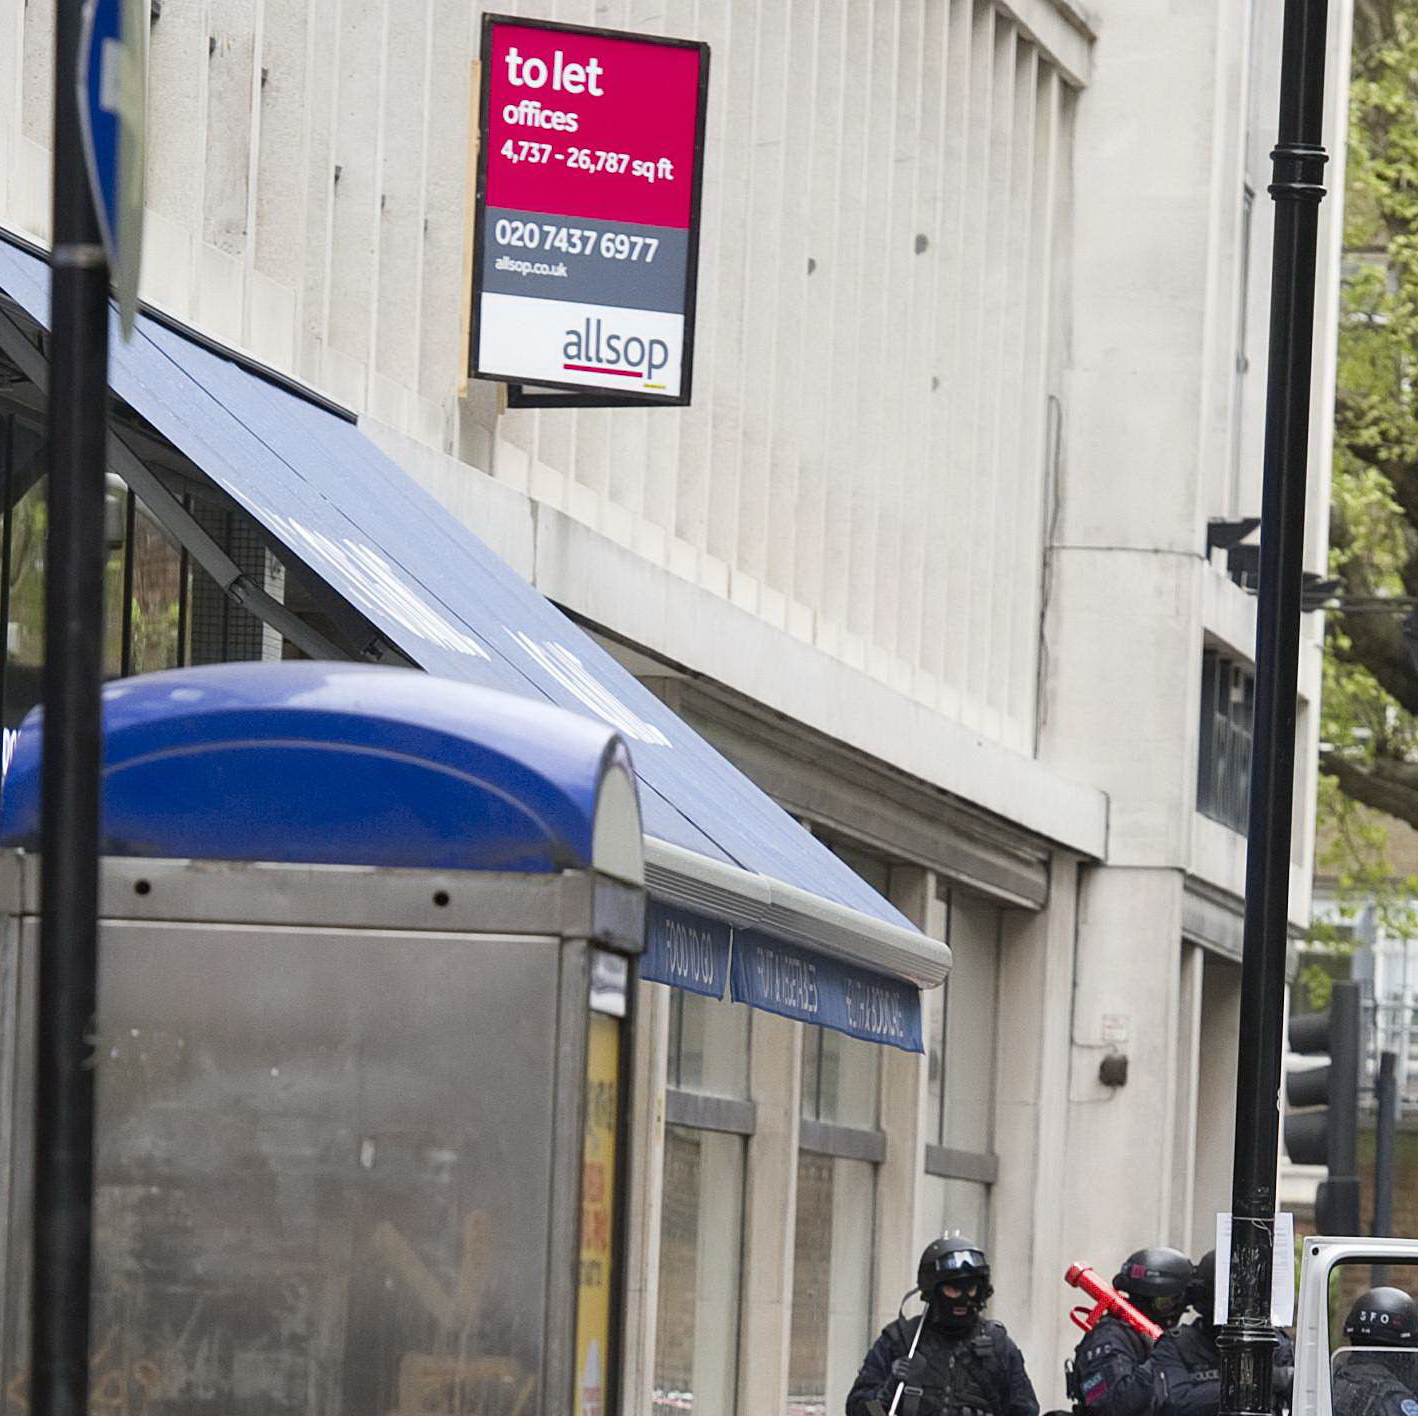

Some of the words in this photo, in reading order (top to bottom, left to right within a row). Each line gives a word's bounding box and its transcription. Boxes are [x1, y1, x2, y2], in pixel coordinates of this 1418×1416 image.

[504, 46, 549, 90] to
[551, 49, 605, 97] let
[502, 99, 579, 133] offices
[500, 138, 553, 164] 4,737
[566, 146, 630, 174] 26,787
[494, 218, 540, 249] 020
[542, 224, 598, 256] 7437
[599, 232, 659, 263] 6977
[494, 255, 569, 278] allsop.co.uk
[562, 316, 670, 381] allsop
[665, 918, 689, 981] FOOD
